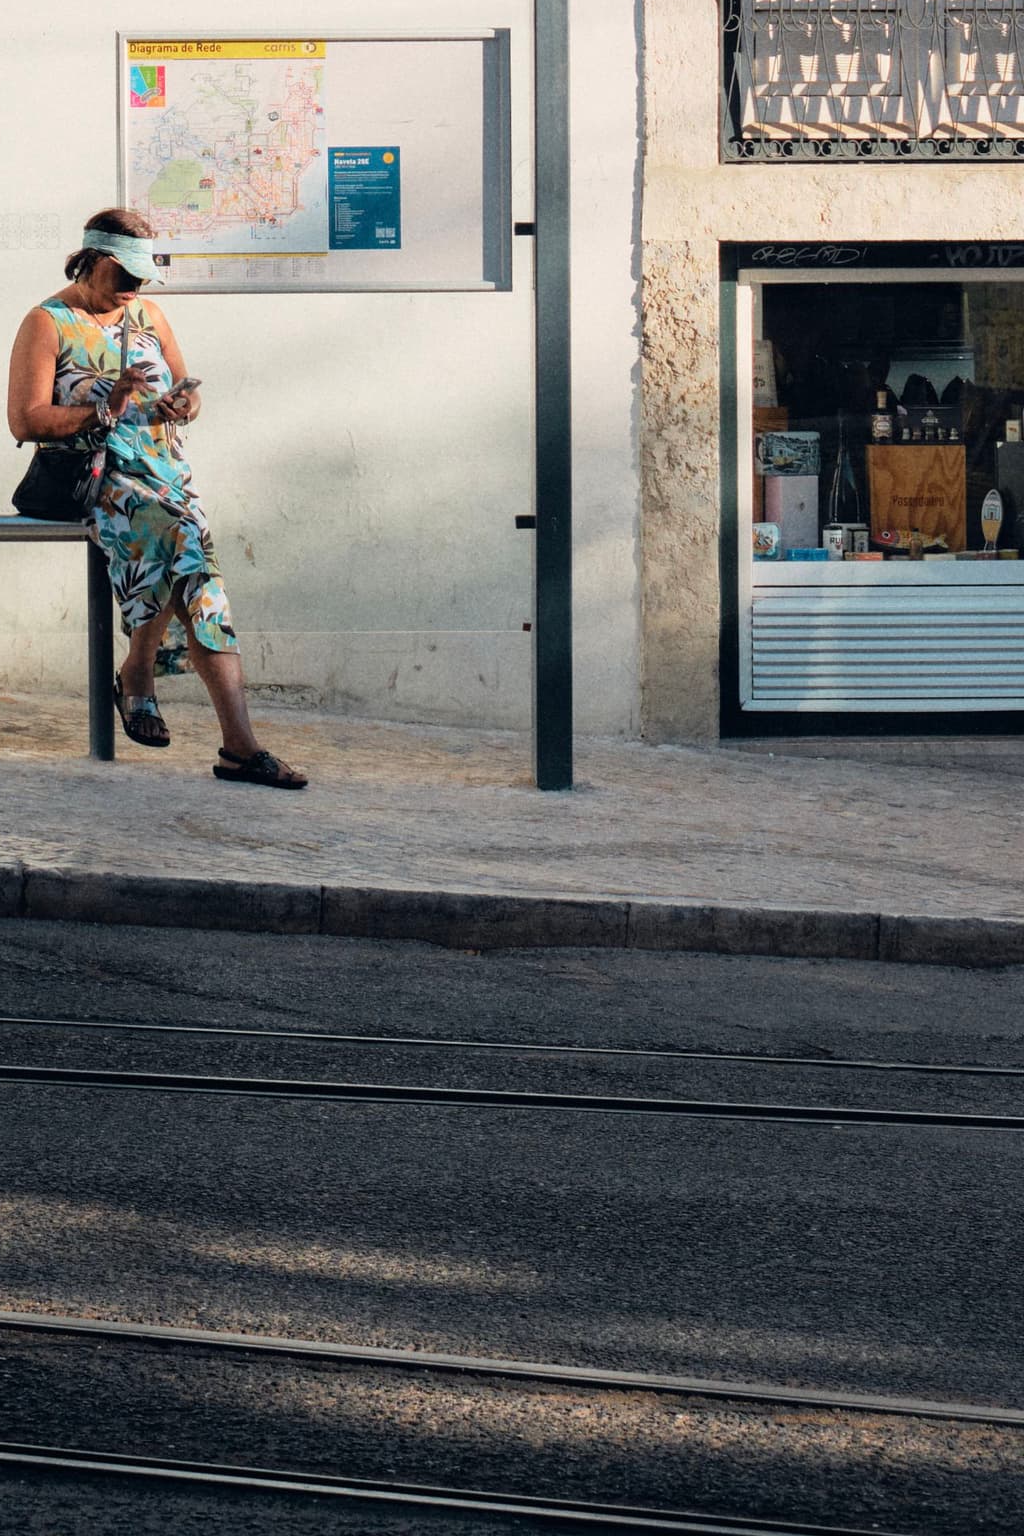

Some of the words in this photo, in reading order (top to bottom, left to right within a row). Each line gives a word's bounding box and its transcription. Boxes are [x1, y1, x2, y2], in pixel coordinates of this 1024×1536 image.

[129, 42, 178, 55] Diagrama
[181, 42, 193, 53] de
[196, 42, 222, 53] Rede
[263, 43, 296, 52] carris
